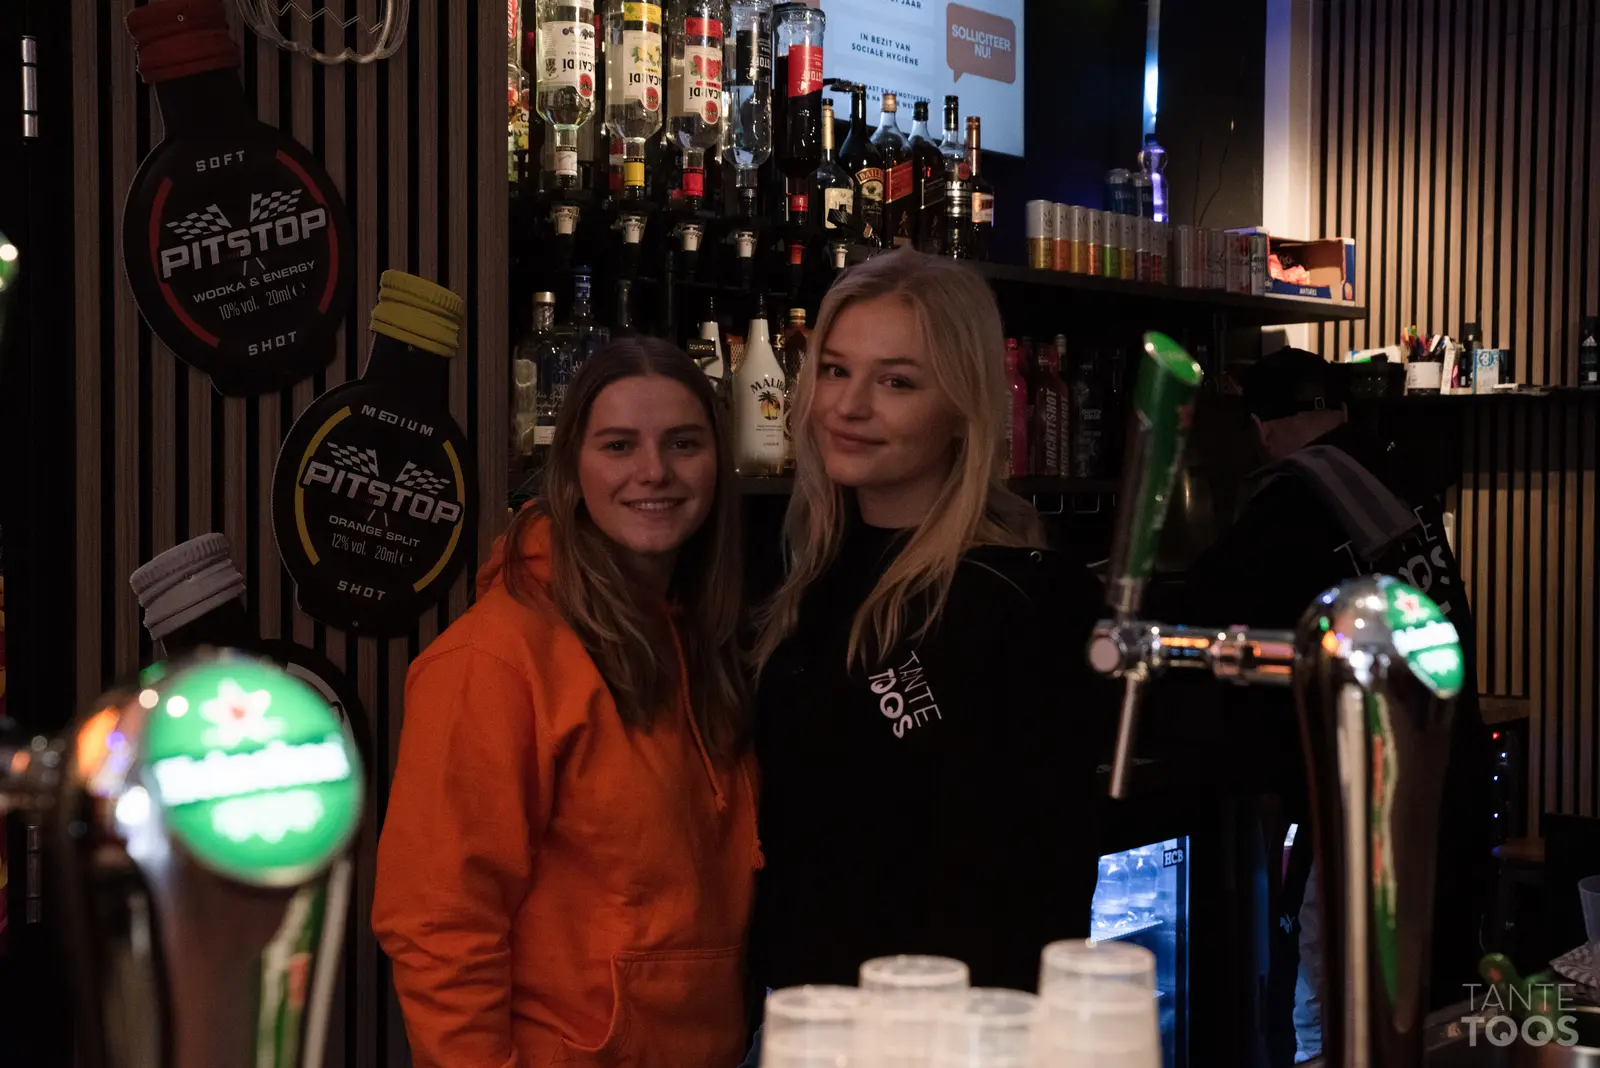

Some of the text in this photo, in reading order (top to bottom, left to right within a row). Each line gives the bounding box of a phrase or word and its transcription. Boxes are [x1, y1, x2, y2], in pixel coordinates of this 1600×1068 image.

[860, 33, 911, 52] IN BEZIT VAN
[951, 24, 1011, 51] SOLLICITEER
[974, 46, 992, 59] NU!
[851, 43, 919, 66] SOCIALE HYGIËNE
[196, 150, 246, 172] SOFT
[160, 207, 327, 279] PITSTOP
[193, 260, 317, 304] WODKA & ENERGY
[218, 288, 291, 321] 10% vol. 20ml
[248, 331, 298, 357] SHOT
[750, 378, 784, 394] MALIB
[360, 404, 435, 437] MEDIUM
[302, 461, 462, 524] PITSTOP
[328, 514, 421, 549] ORANGE SPLIT
[331, 532, 399, 565] 12% vol. 20ml
[336, 580, 387, 602] SHOT
[868, 668, 913, 739] TOOS
[898, 650, 942, 728] TANTE
[1164, 849, 1184, 866] HCB
